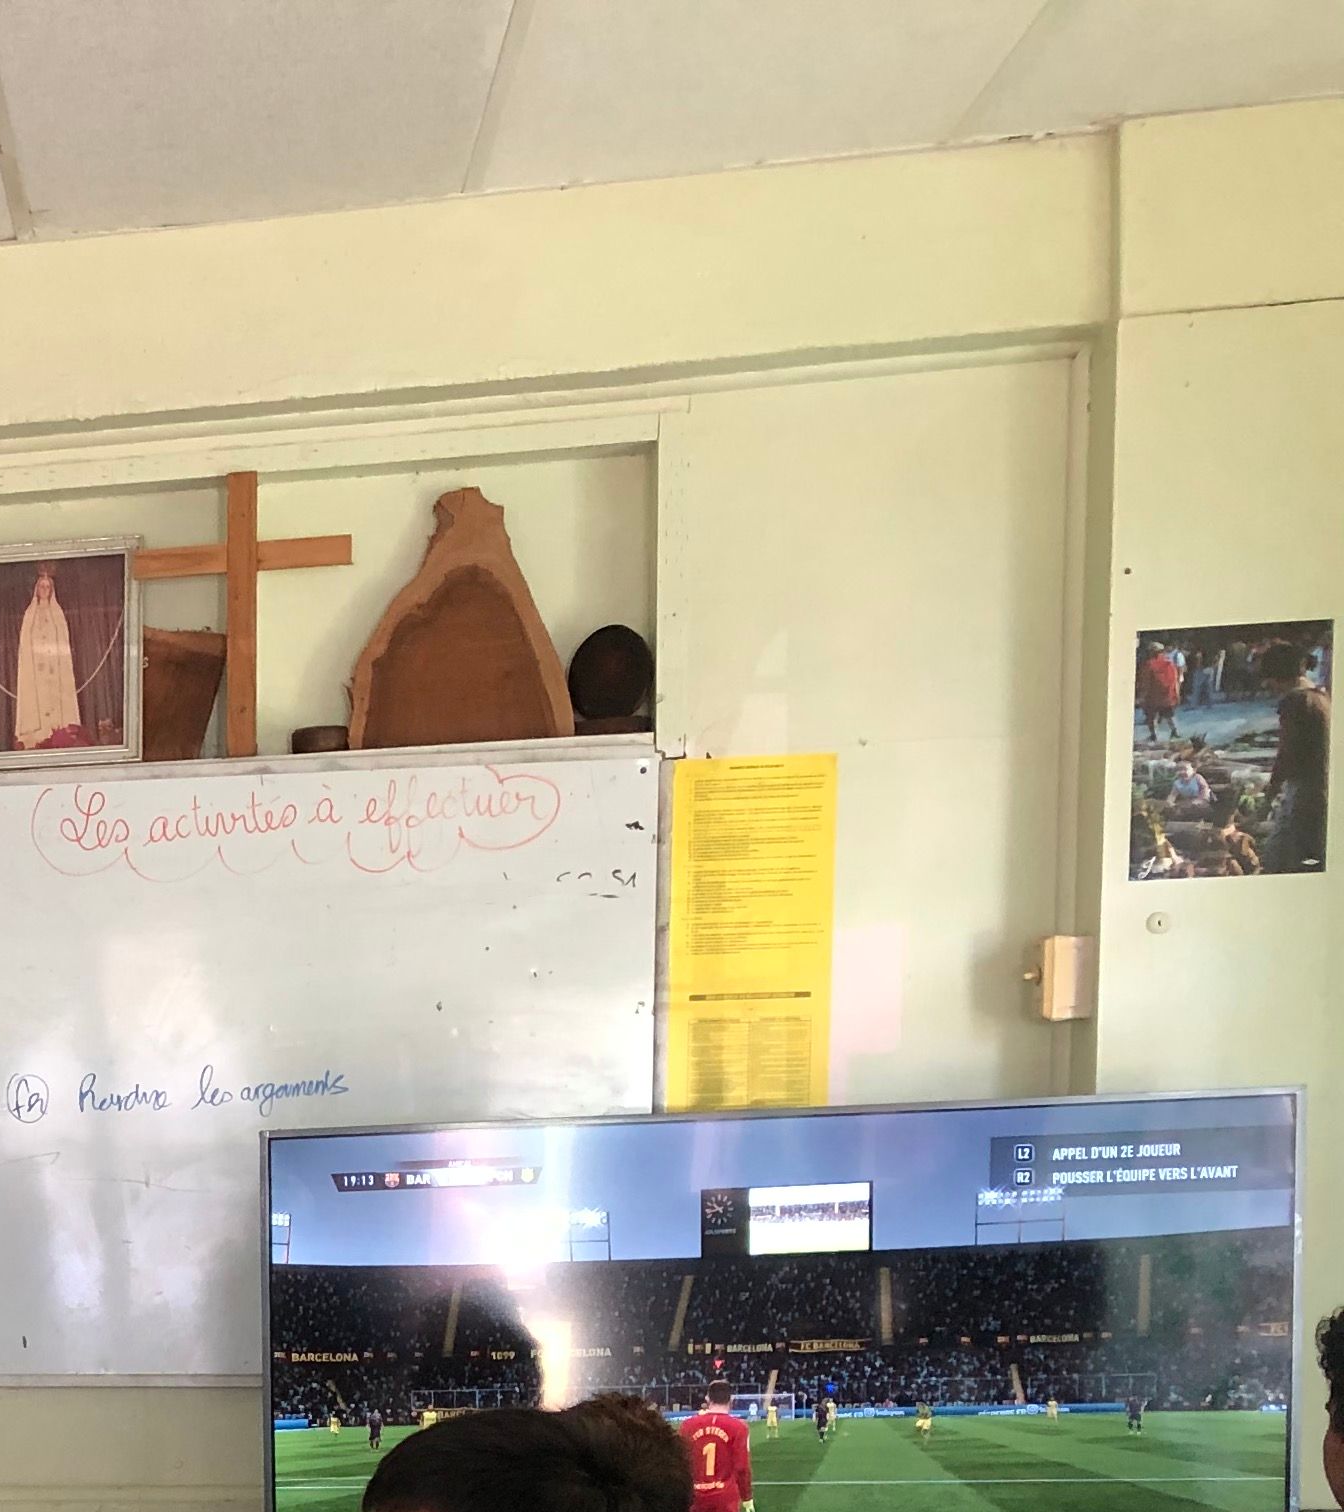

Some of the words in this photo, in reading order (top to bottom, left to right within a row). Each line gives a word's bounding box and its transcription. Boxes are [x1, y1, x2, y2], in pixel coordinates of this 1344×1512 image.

[60, 784, 130, 851] Les
[308, 784, 342, 824] à
[358, 775, 547, 858] effectuer
[191, 1064, 234, 1110] les
[1018, 1148, 1030, 1159] L2
[1052, 1147, 1088, 1161] APPEL
[1091, 1145, 1118, 1159] D'UN
[1121, 1145, 1134, 1158] 2E
[1137, 1143, 1181, 1157] JOUEUR
[343, 1175, 374, 1186] 19:13
[406, 1174, 431, 1186] BAR
[1017, 1172, 1030, 1183] R2
[1052, 1171, 1105, 1184] POUSSER
[1107, 1168, 1156, 1183] L'ÉQUIPE
[1159, 1167, 1187, 1180] VERS
[1190, 1165, 1238, 1179] L'AVANT
[292, 1352, 359, 1362] BARCELONA
[703, 1442, 716, 1476] 1
